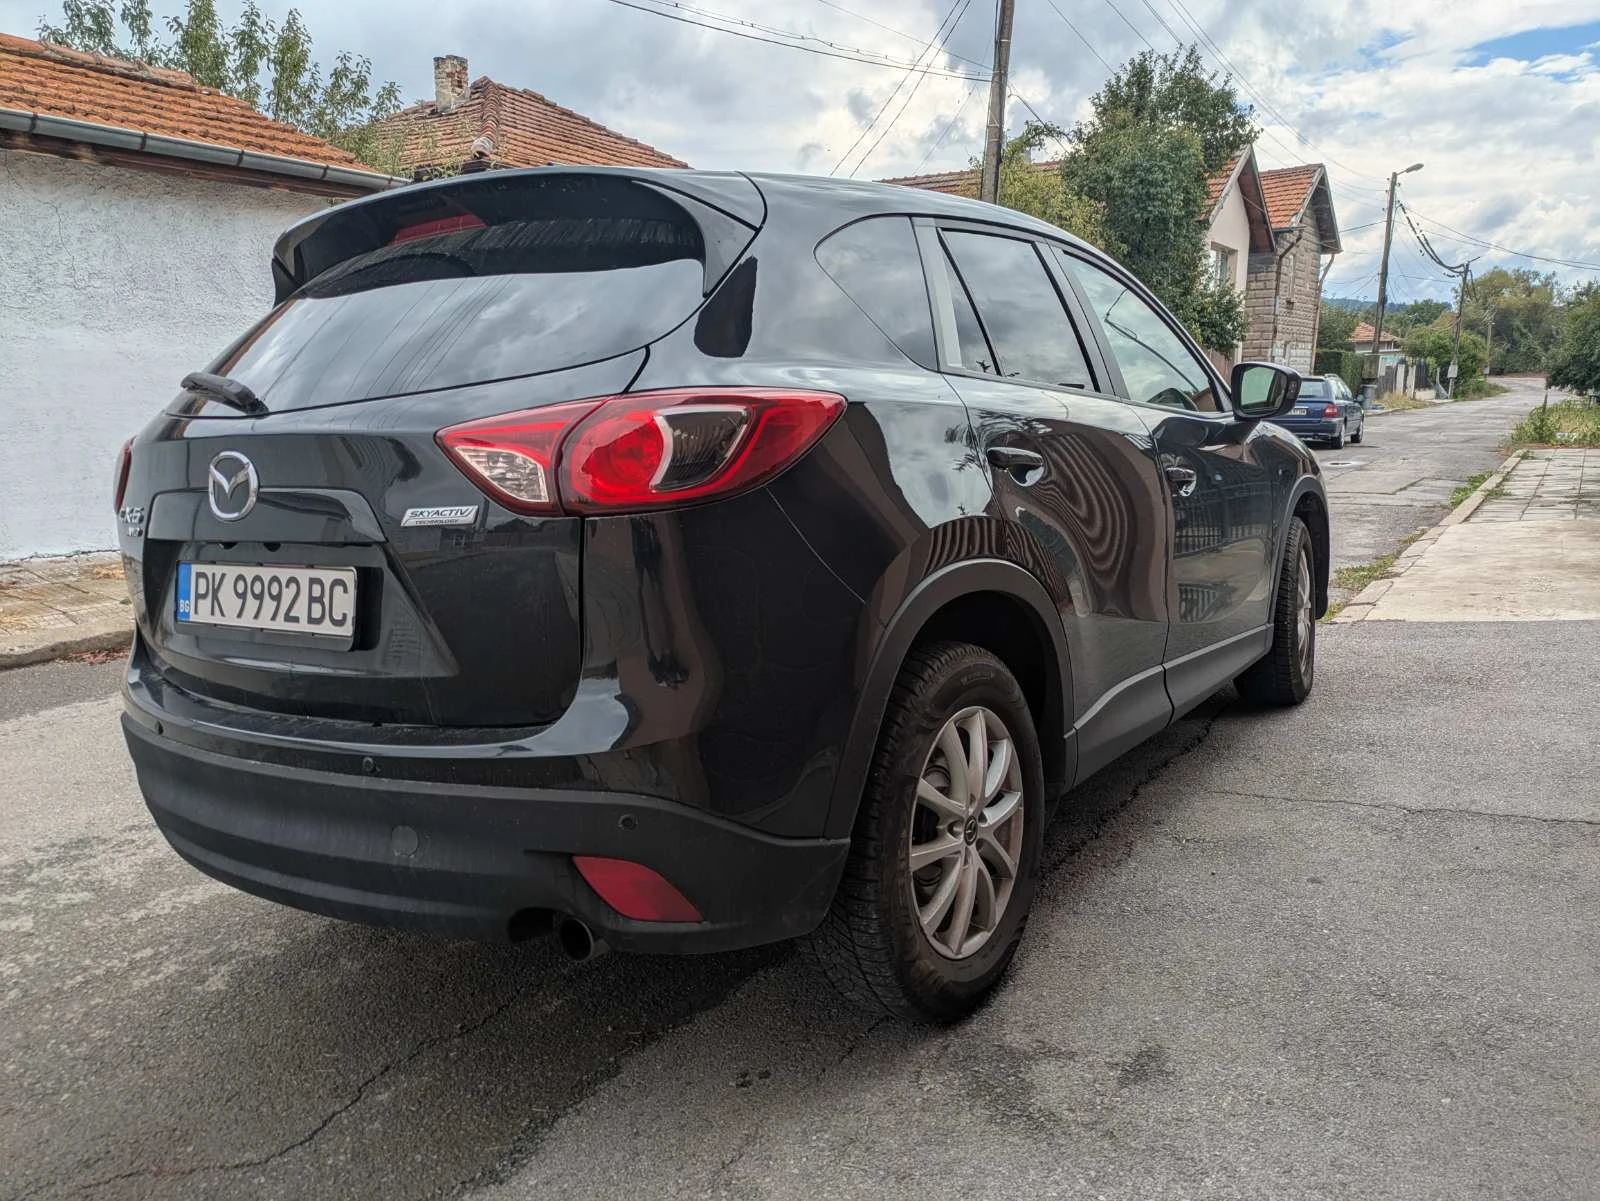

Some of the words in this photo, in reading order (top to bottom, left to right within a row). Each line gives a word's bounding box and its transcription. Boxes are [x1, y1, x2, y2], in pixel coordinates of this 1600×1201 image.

[409, 508, 469, 518] SKYACTIV
[179, 599, 190, 613] BG
[194, 571, 227, 617] PK
[233, 573, 301, 624] 9992
[307, 577, 349, 627] BC
